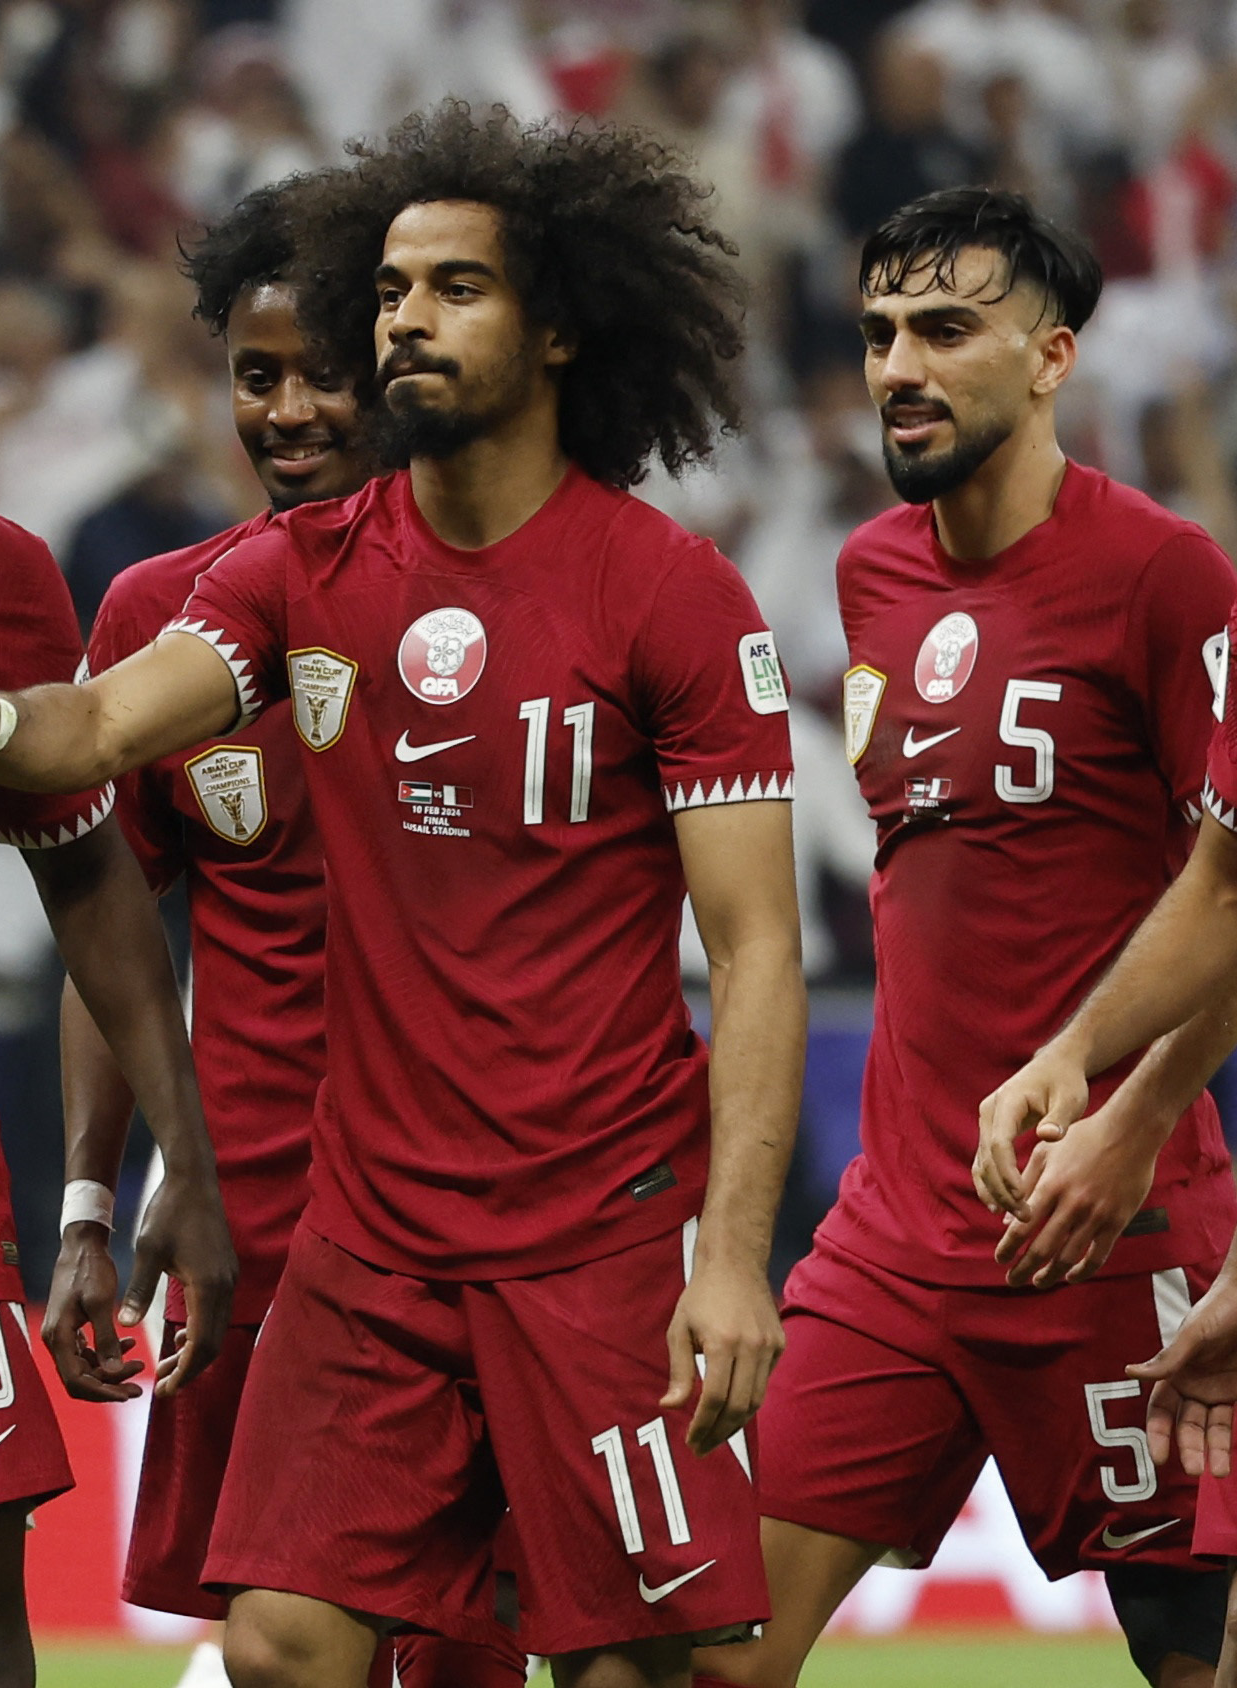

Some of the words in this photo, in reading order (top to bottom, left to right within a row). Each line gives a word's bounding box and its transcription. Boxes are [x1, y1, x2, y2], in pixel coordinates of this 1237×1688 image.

[750, 644, 770, 658] AFC
[298, 663, 322, 674] ASIAN
[323, 667, 343, 676] CUP
[298, 681, 339, 694] CHAMPIONS
[995, 679, 1062, 803] 5
[201, 763, 227, 775] ASIAN
[229, 759, 247, 769] CUP
[215, 756, 229, 764] AFC
[519, 697, 594, 825] 11
[206, 777, 251, 792] CHAMPIONS
[412, 805, 422, 813] 10
[424, 806, 439, 815] FEB
[441, 808, 461, 817] 2024
[423, 816, 449, 826] FINAL
[403, 821, 431, 834] LUSAIL
[432, 826, 470, 837] STADIUM
[1084, 1380, 1157, 1502] 5
[592, 1416, 691, 1554] 11
